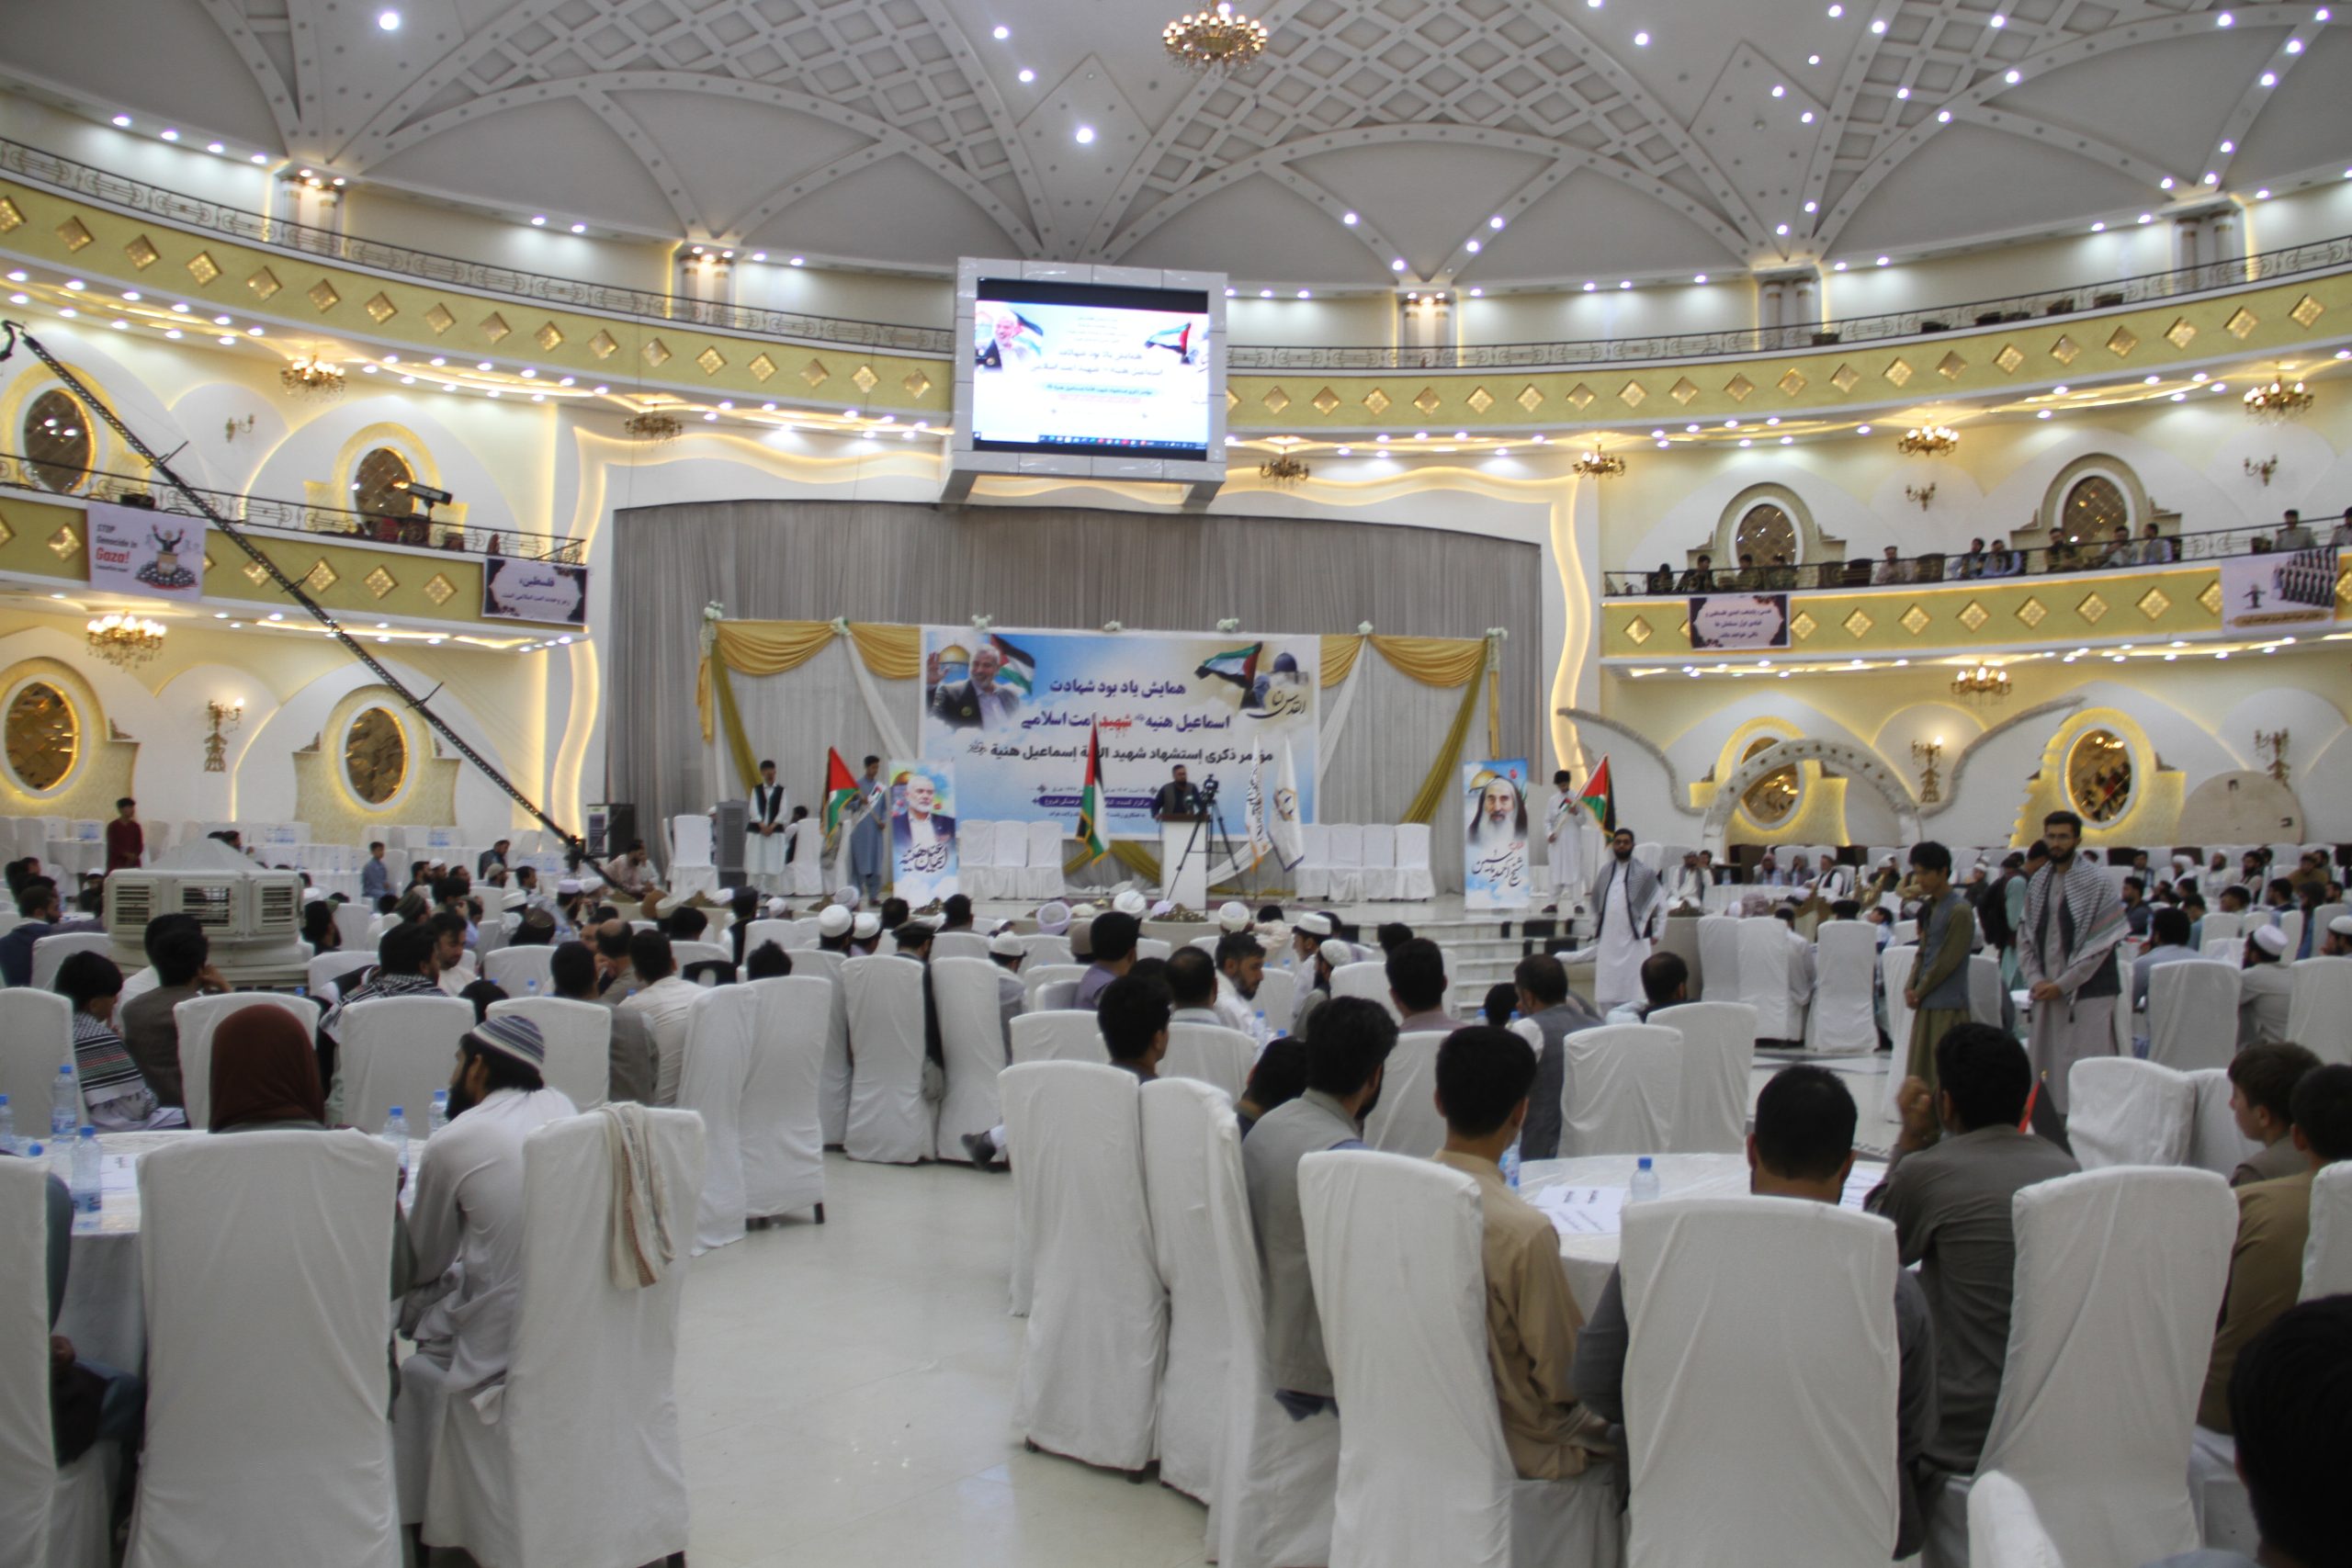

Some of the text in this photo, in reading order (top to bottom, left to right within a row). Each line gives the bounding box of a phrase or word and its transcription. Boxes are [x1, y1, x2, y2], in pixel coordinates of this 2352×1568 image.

[96, 536, 130, 547] Genocide
[96, 547, 130, 564] Gaza!
[1049, 678, 1187, 698] همایش یاد بود شهادت
[1099, 713, 1133, 730] شهید
[1145, 714, 1173, 731] هنیه
[1175, 714, 1231, 732] اسماعیل
